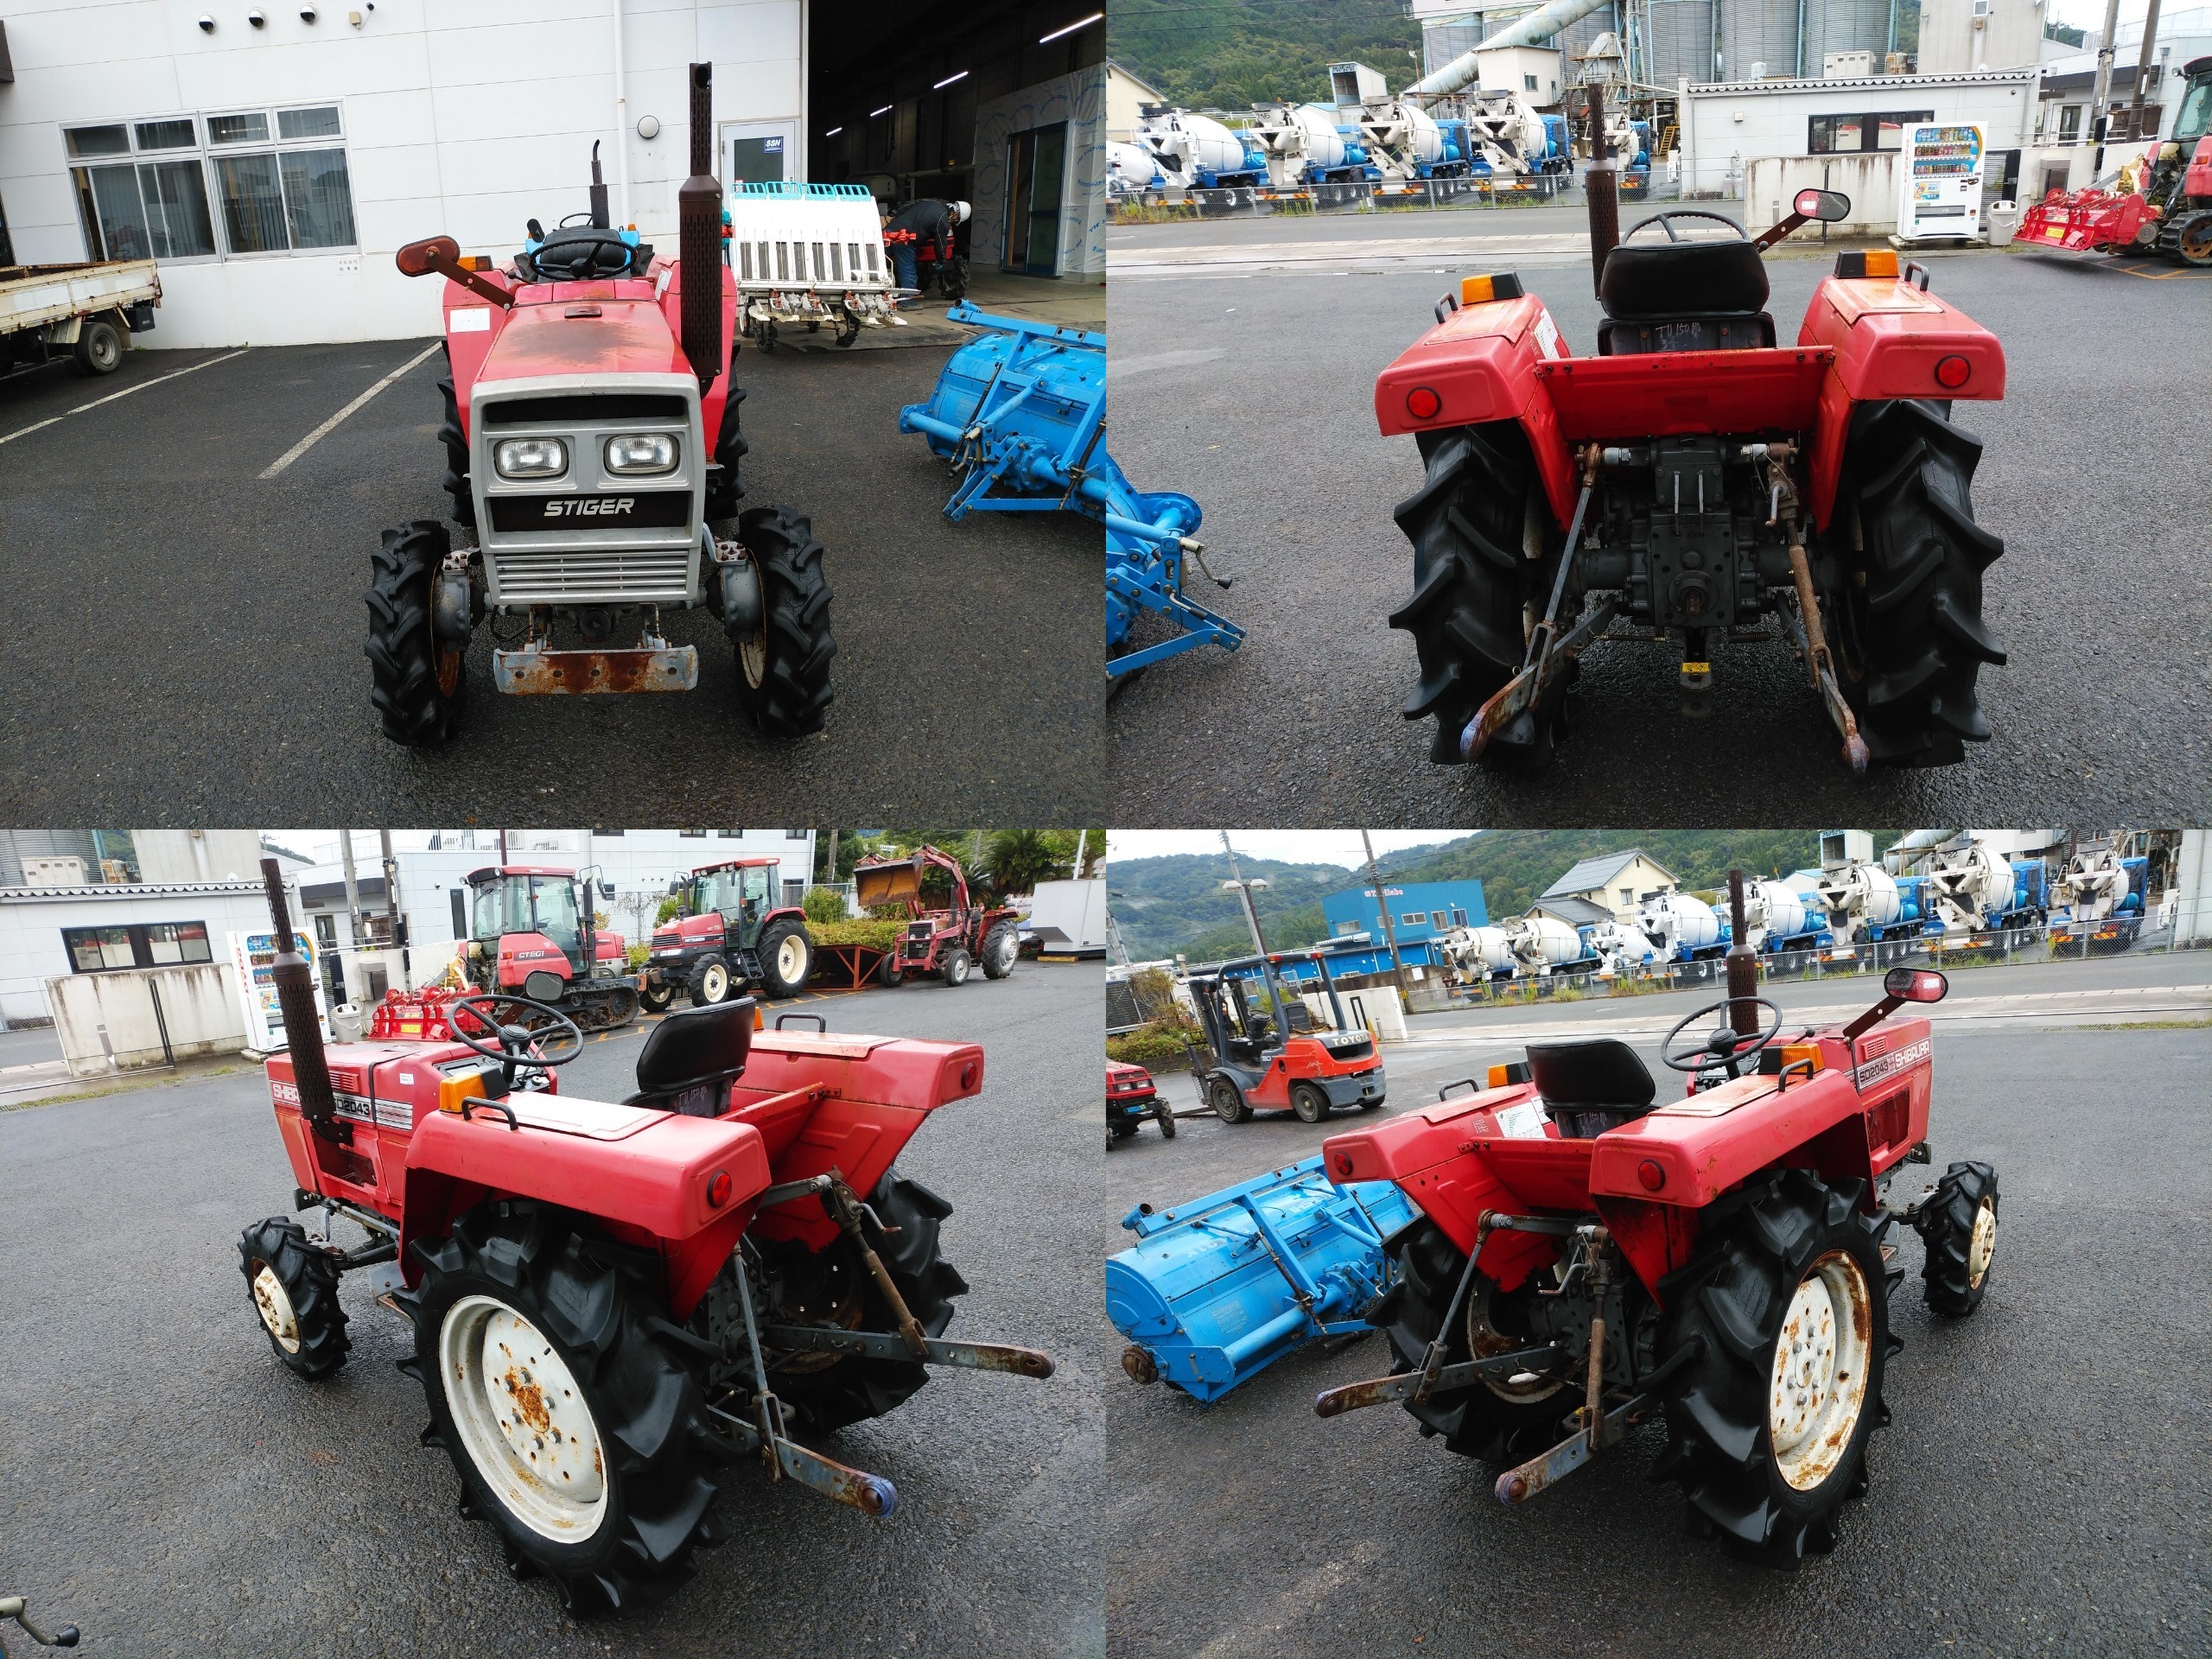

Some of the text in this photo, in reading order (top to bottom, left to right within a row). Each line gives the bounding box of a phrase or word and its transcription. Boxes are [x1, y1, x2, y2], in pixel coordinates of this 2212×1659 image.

[766, 138, 781, 147] SSN
[543, 498, 635, 517] STIGER
[1332, 1033, 1371, 1046] TOYOTA
[1895, 1040, 1930, 1068] SHIBAURA
[1859, 1060, 1889, 1084] SD2043
[272, 1084, 301, 1103] SHIBA
